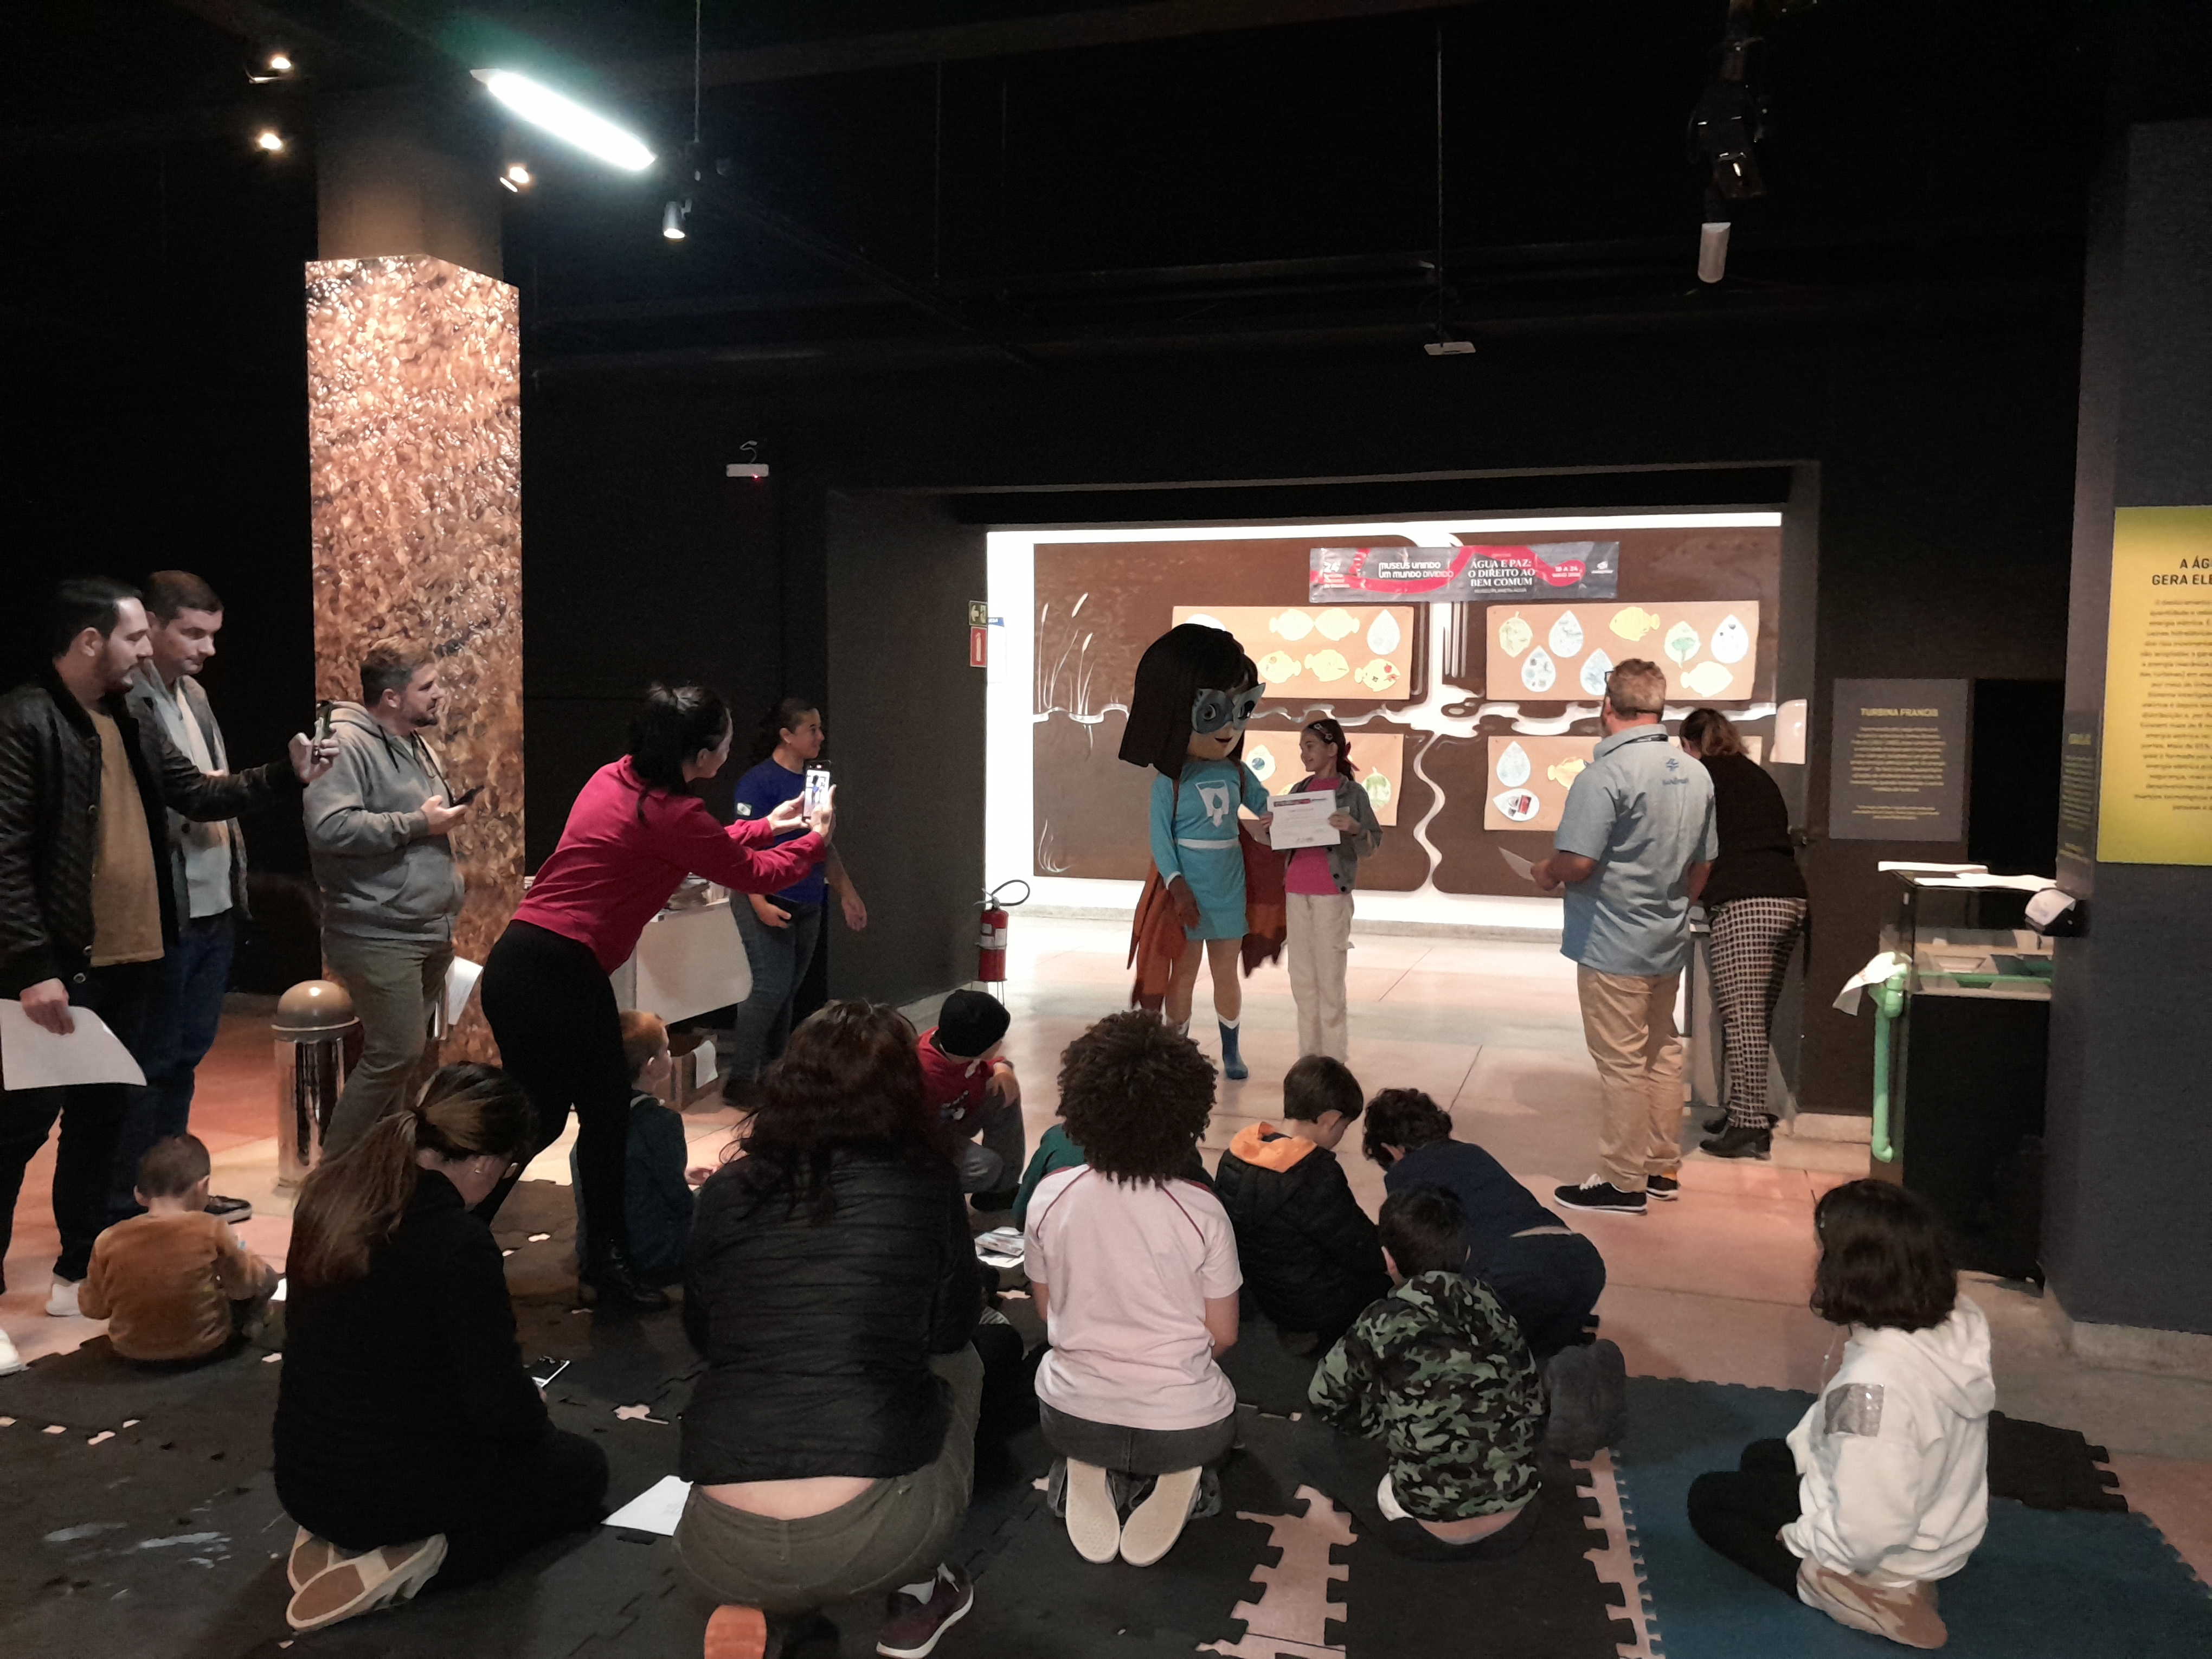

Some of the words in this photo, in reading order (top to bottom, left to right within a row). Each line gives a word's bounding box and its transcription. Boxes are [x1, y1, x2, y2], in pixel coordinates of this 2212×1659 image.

[1470, 558, 1499, 569] ÁGUA
[1501, 559, 1508, 568] E
[1509, 558, 1532, 568] PAZ:
[2179, 558, 2188, 569] A
[2192, 555, 2210, 569] ÁG
[1468, 570, 1476, 578] O
[1478, 568, 1519, 577] DIREITO
[1520, 568, 1536, 576] AO
[1470, 578, 1491, 587] BEM
[1493, 577, 1533, 586] COMUM
[2152, 574, 2188, 586] GERA
